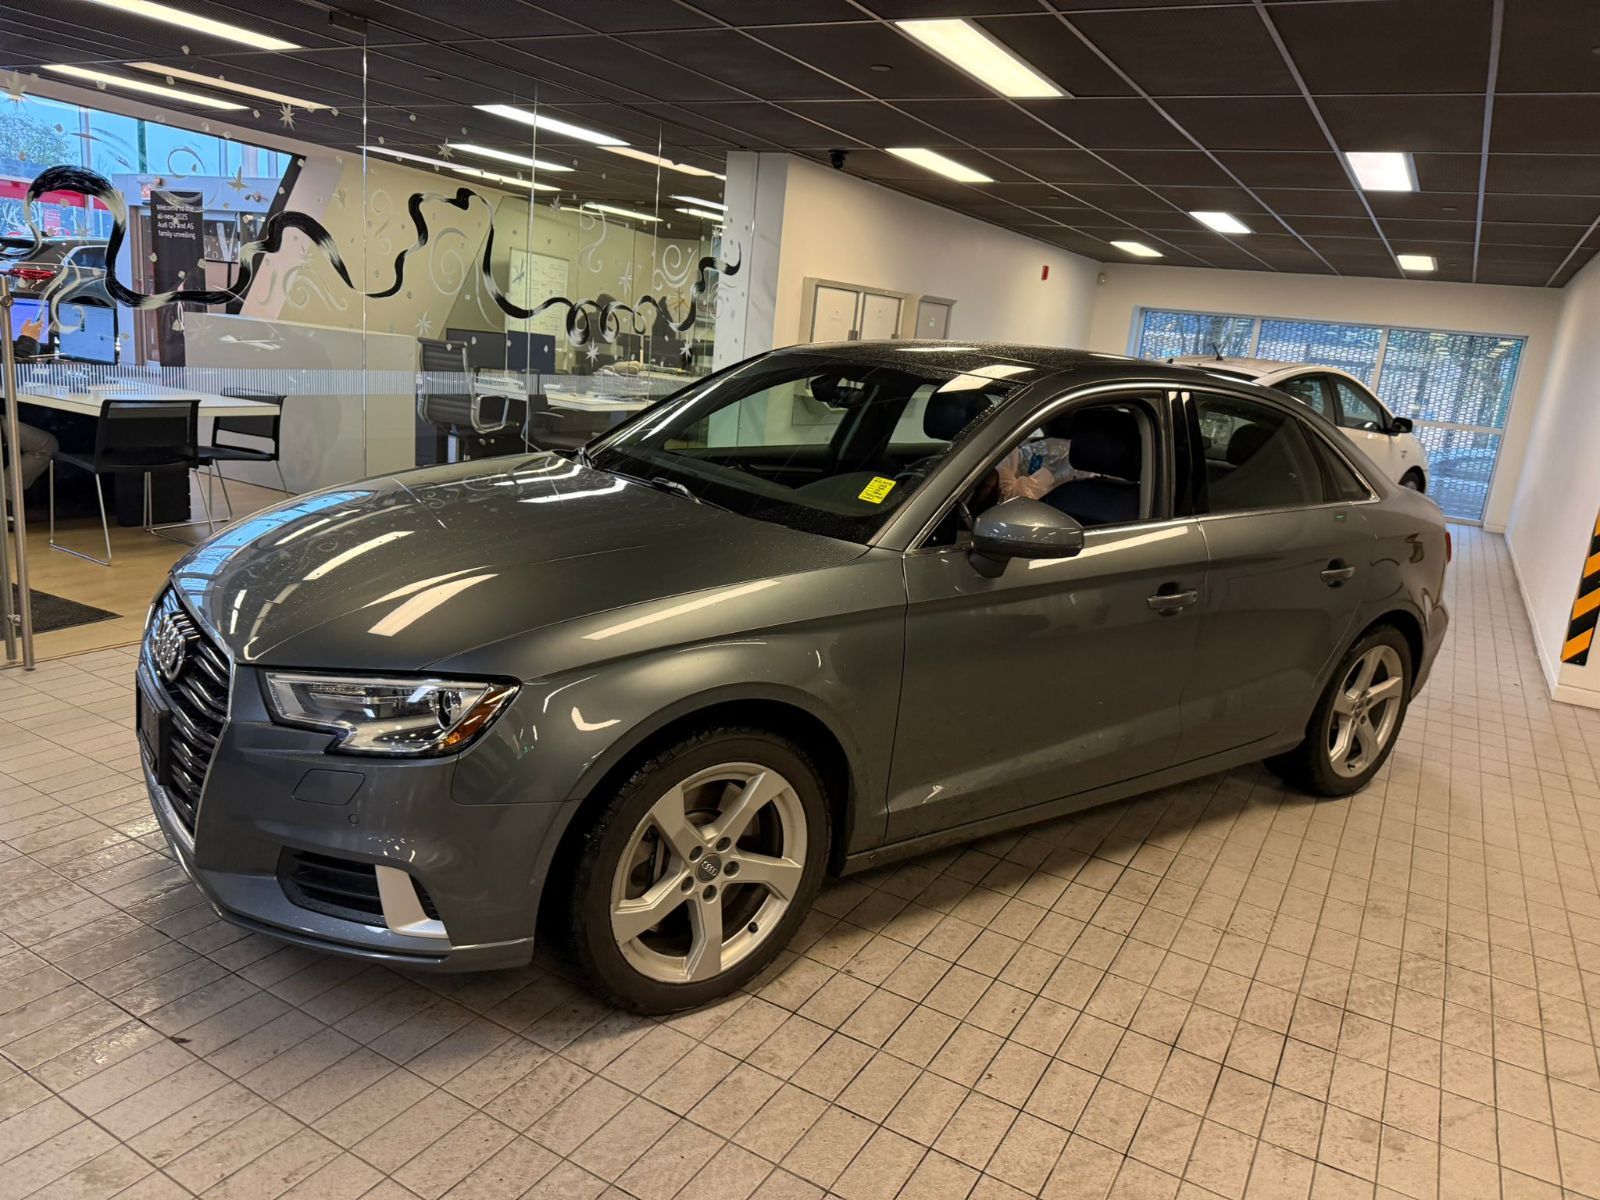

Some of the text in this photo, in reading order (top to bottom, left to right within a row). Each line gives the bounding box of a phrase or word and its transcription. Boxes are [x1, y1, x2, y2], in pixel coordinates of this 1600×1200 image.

[156, 203, 178, 211] Welcome
[158, 221, 168, 229] Audi
[158, 230, 196, 240] family unveiling
